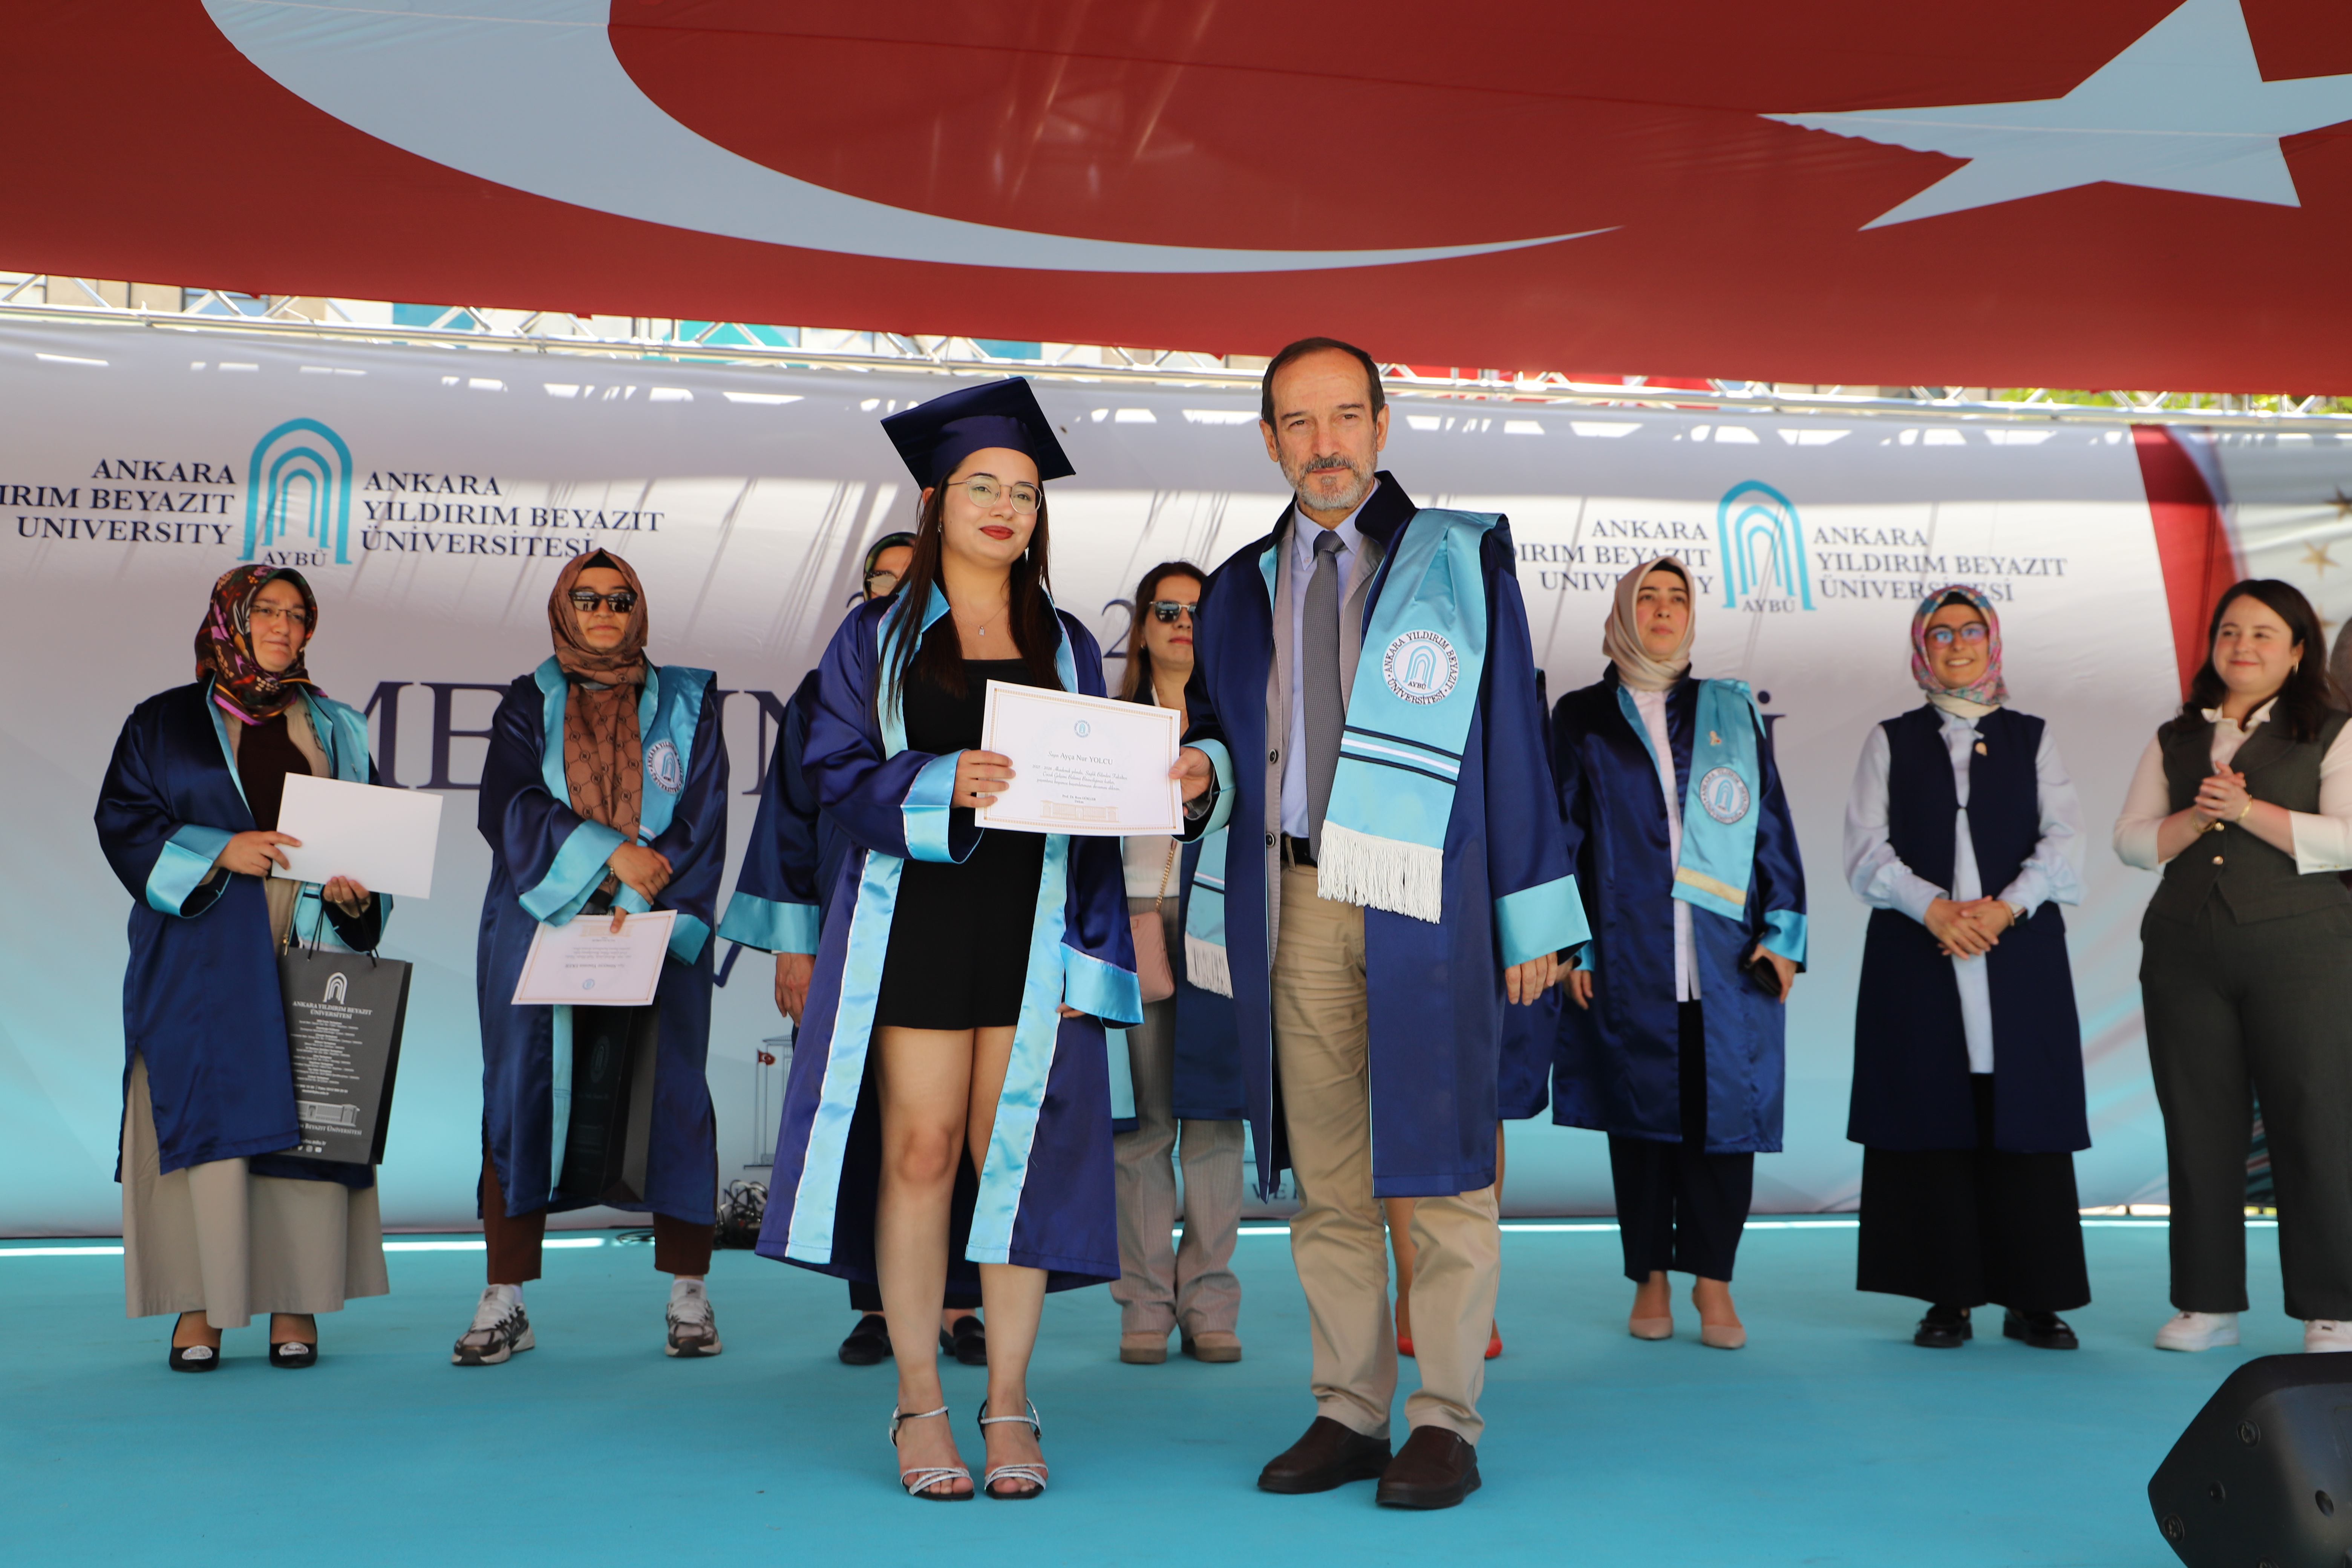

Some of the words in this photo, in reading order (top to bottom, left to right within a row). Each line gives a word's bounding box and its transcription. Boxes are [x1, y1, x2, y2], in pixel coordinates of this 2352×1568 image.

[91, 458, 237, 484] ANKARA
[363, 471, 503, 496] ANKARA
[0, 485, 80, 508] IRIM
[89, 488, 235, 514] BEYAZIT
[363, 500, 521, 526] YILDIRIM
[530, 507, 665, 531] BEYAZIT
[16, 516, 233, 545] UNIVERSITY
[360, 525, 594, 557] ÜNİVERSİTESİ
[1592, 519, 1708, 540] ANKARA
[1813, 526, 1928, 547] ANKARA
[262, 549, 328, 566] AYBÜ
[1514, 543, 1586, 563] IRIM
[1817, 552, 1948, 574] YILDIRIM
[1954, 556, 2068, 576] BEYAZIT
[1742, 597, 1796, 613] AYBÜ
[1384, 637, 1405, 673] ANKARA
[1406, 631, 1450, 650] YILDIRIM
[1446, 649, 1458, 690] BEYAZIT
[1387, 677, 1446, 705] ÜNİVERSİTESİ
[1408, 680, 1426, 690] AYBÜ
[1061, 752, 1074, 761] Ayça
[1089, 756, 1113, 765] YOLCU
